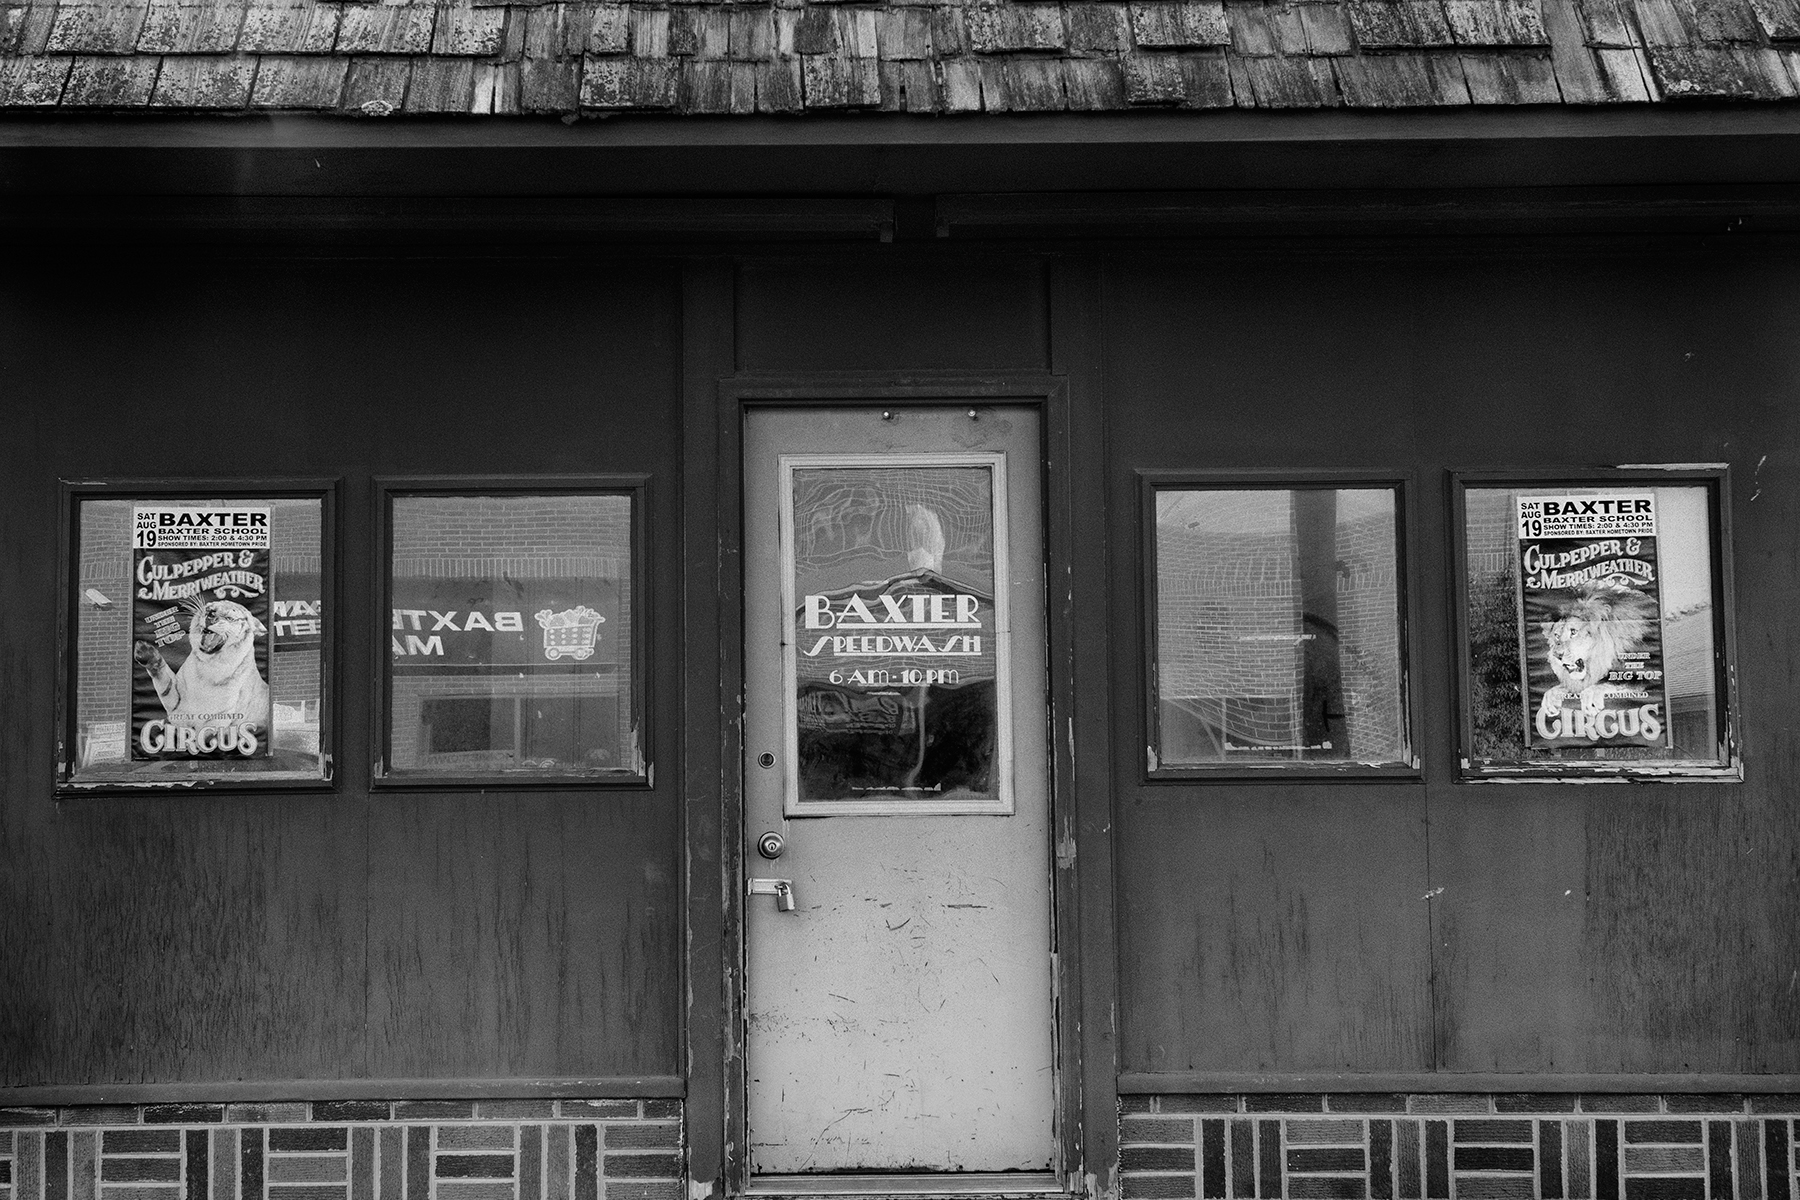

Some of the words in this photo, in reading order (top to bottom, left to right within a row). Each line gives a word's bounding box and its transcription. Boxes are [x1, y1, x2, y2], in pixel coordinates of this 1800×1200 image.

[1521, 502, 1540, 510] SAT
[1543, 499, 1653, 516] BAXTER
[137, 512, 157, 520] SAT
[159, 512, 268, 527] BAXTER
[1521, 511, 1541, 519] AUG
[136, 521, 157, 529] AUG
[1522, 519, 1542, 537] 19
[136, 530, 157, 547] 19
[1523, 539, 1624, 575] CULPEPPER
[1625, 537, 1642, 556] &
[137, 551, 236, 586] CULPEPPER
[238, 549, 254, 568] &
[1526, 576, 1541, 589] &
[1540, 558, 1656, 590] MERRIWEATHER
[138, 587, 153, 600] &
[152, 570, 266, 600] MERRIWEATHER
[804, 592, 981, 629] BAXTER
[154, 629, 187, 648] TOP
[803, 634, 981, 657] SPEEDWASH
[829, 669, 843, 684] 6
[900, 669, 922, 684] 10
[1608, 671, 1634, 681] BIG
[1635, 670, 1663, 680] TOP
[1604, 691, 1649, 699] COMBINED
[198, 713, 244, 721] COMBINED
[1536, 703, 1661, 741] CIRCUS
[140, 719, 258, 755] CIRCUS
